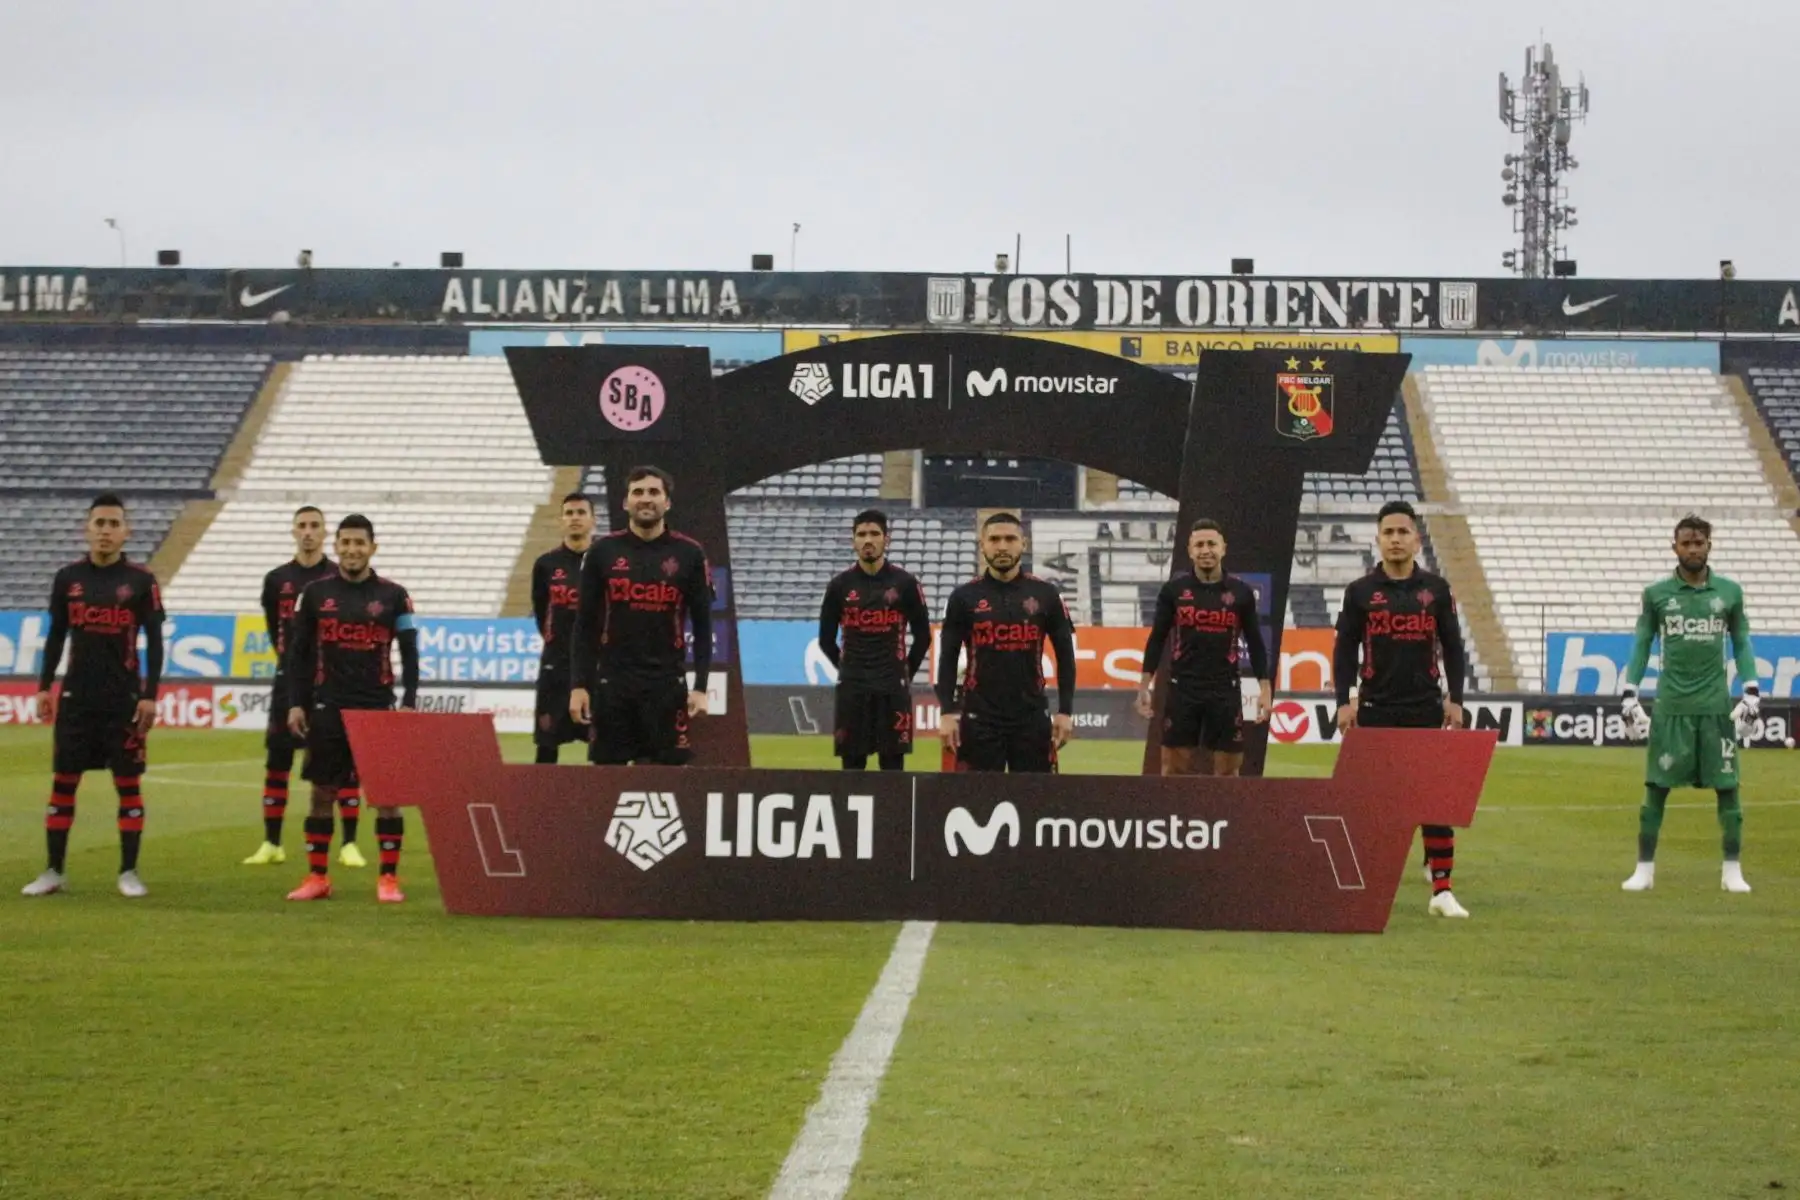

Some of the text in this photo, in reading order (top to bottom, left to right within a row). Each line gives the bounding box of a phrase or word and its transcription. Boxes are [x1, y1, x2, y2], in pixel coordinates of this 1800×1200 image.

[442, 277, 741, 316] ALIANZA LIMA
[971, 277, 1430, 328] LOS DE ORIENTE
[609, 378, 652, 421] SBA
[1015, 374, 1118, 394] movistar
[1684, 615, 1723, 633] caja
[1554, 707, 1625, 745] caja
[1035, 815, 1227, 850] movistar
